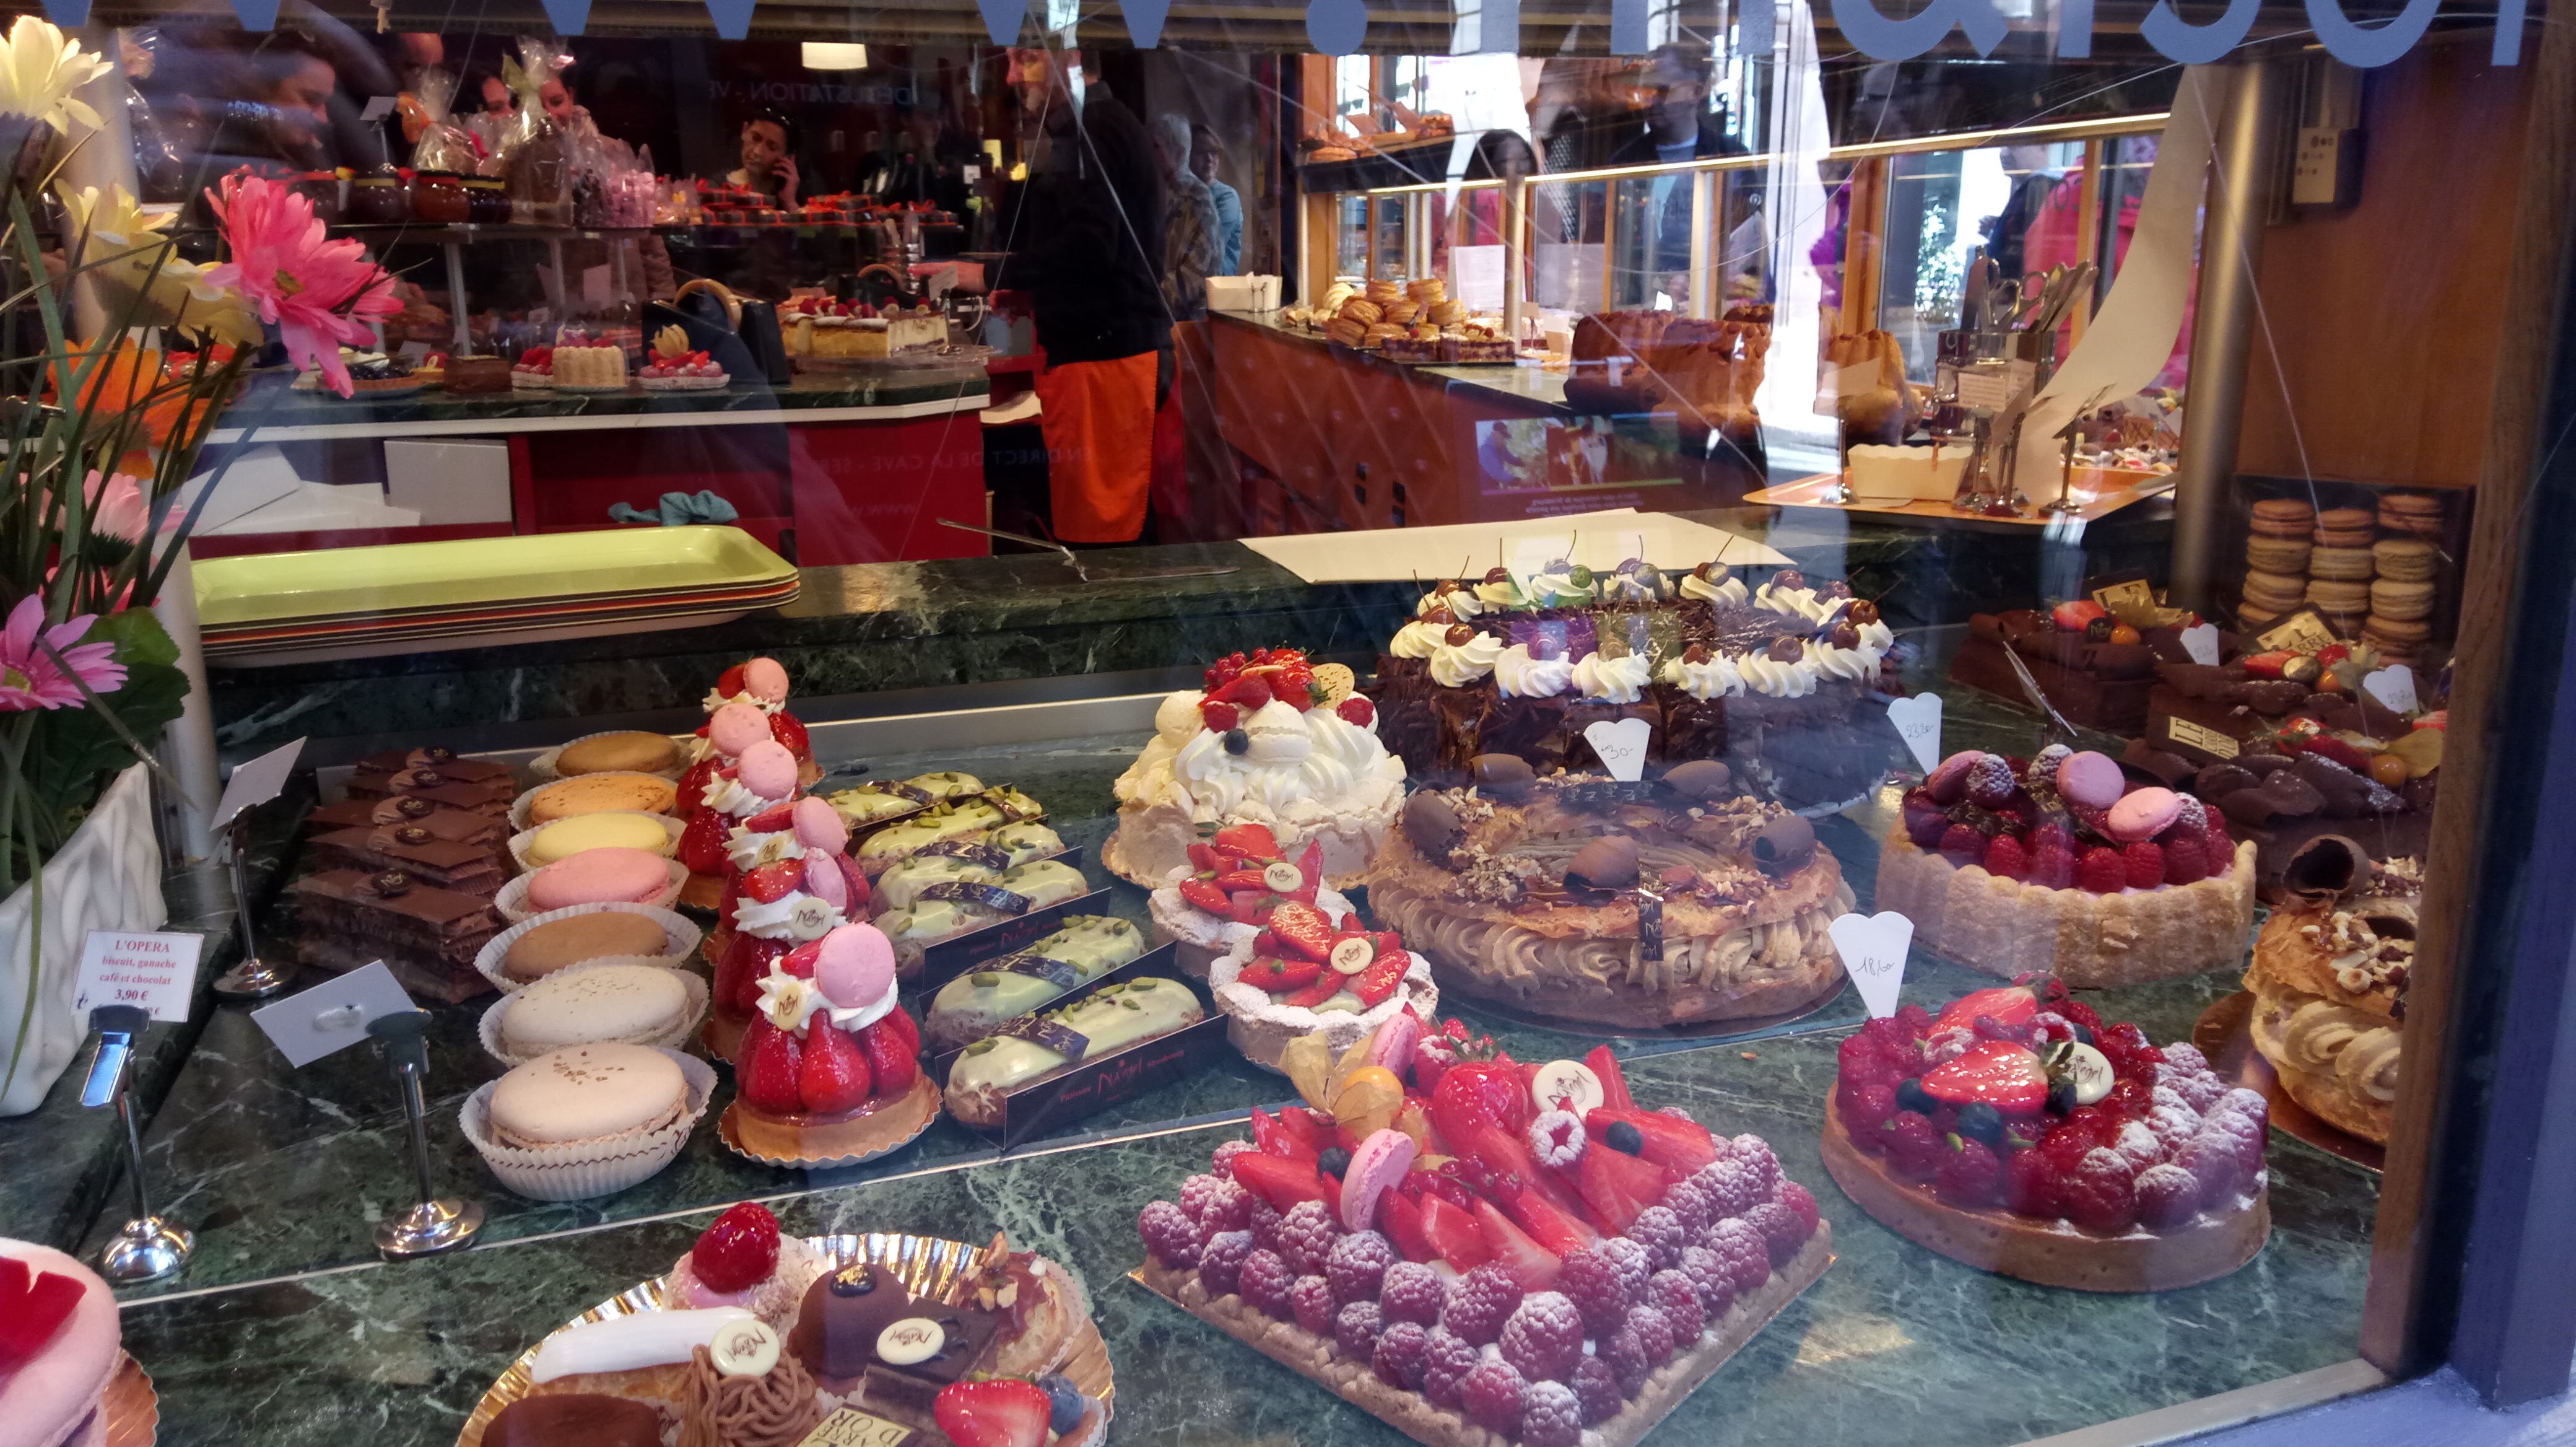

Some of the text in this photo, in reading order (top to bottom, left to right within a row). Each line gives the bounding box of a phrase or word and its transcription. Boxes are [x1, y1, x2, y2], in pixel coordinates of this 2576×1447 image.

[115, 939, 170, 953] L'OPERA
[102, 955, 177, 969] biscuit, ganache
[99, 972, 173, 986] café et chocolat
[115, 989, 149, 1002] 3,90 €
